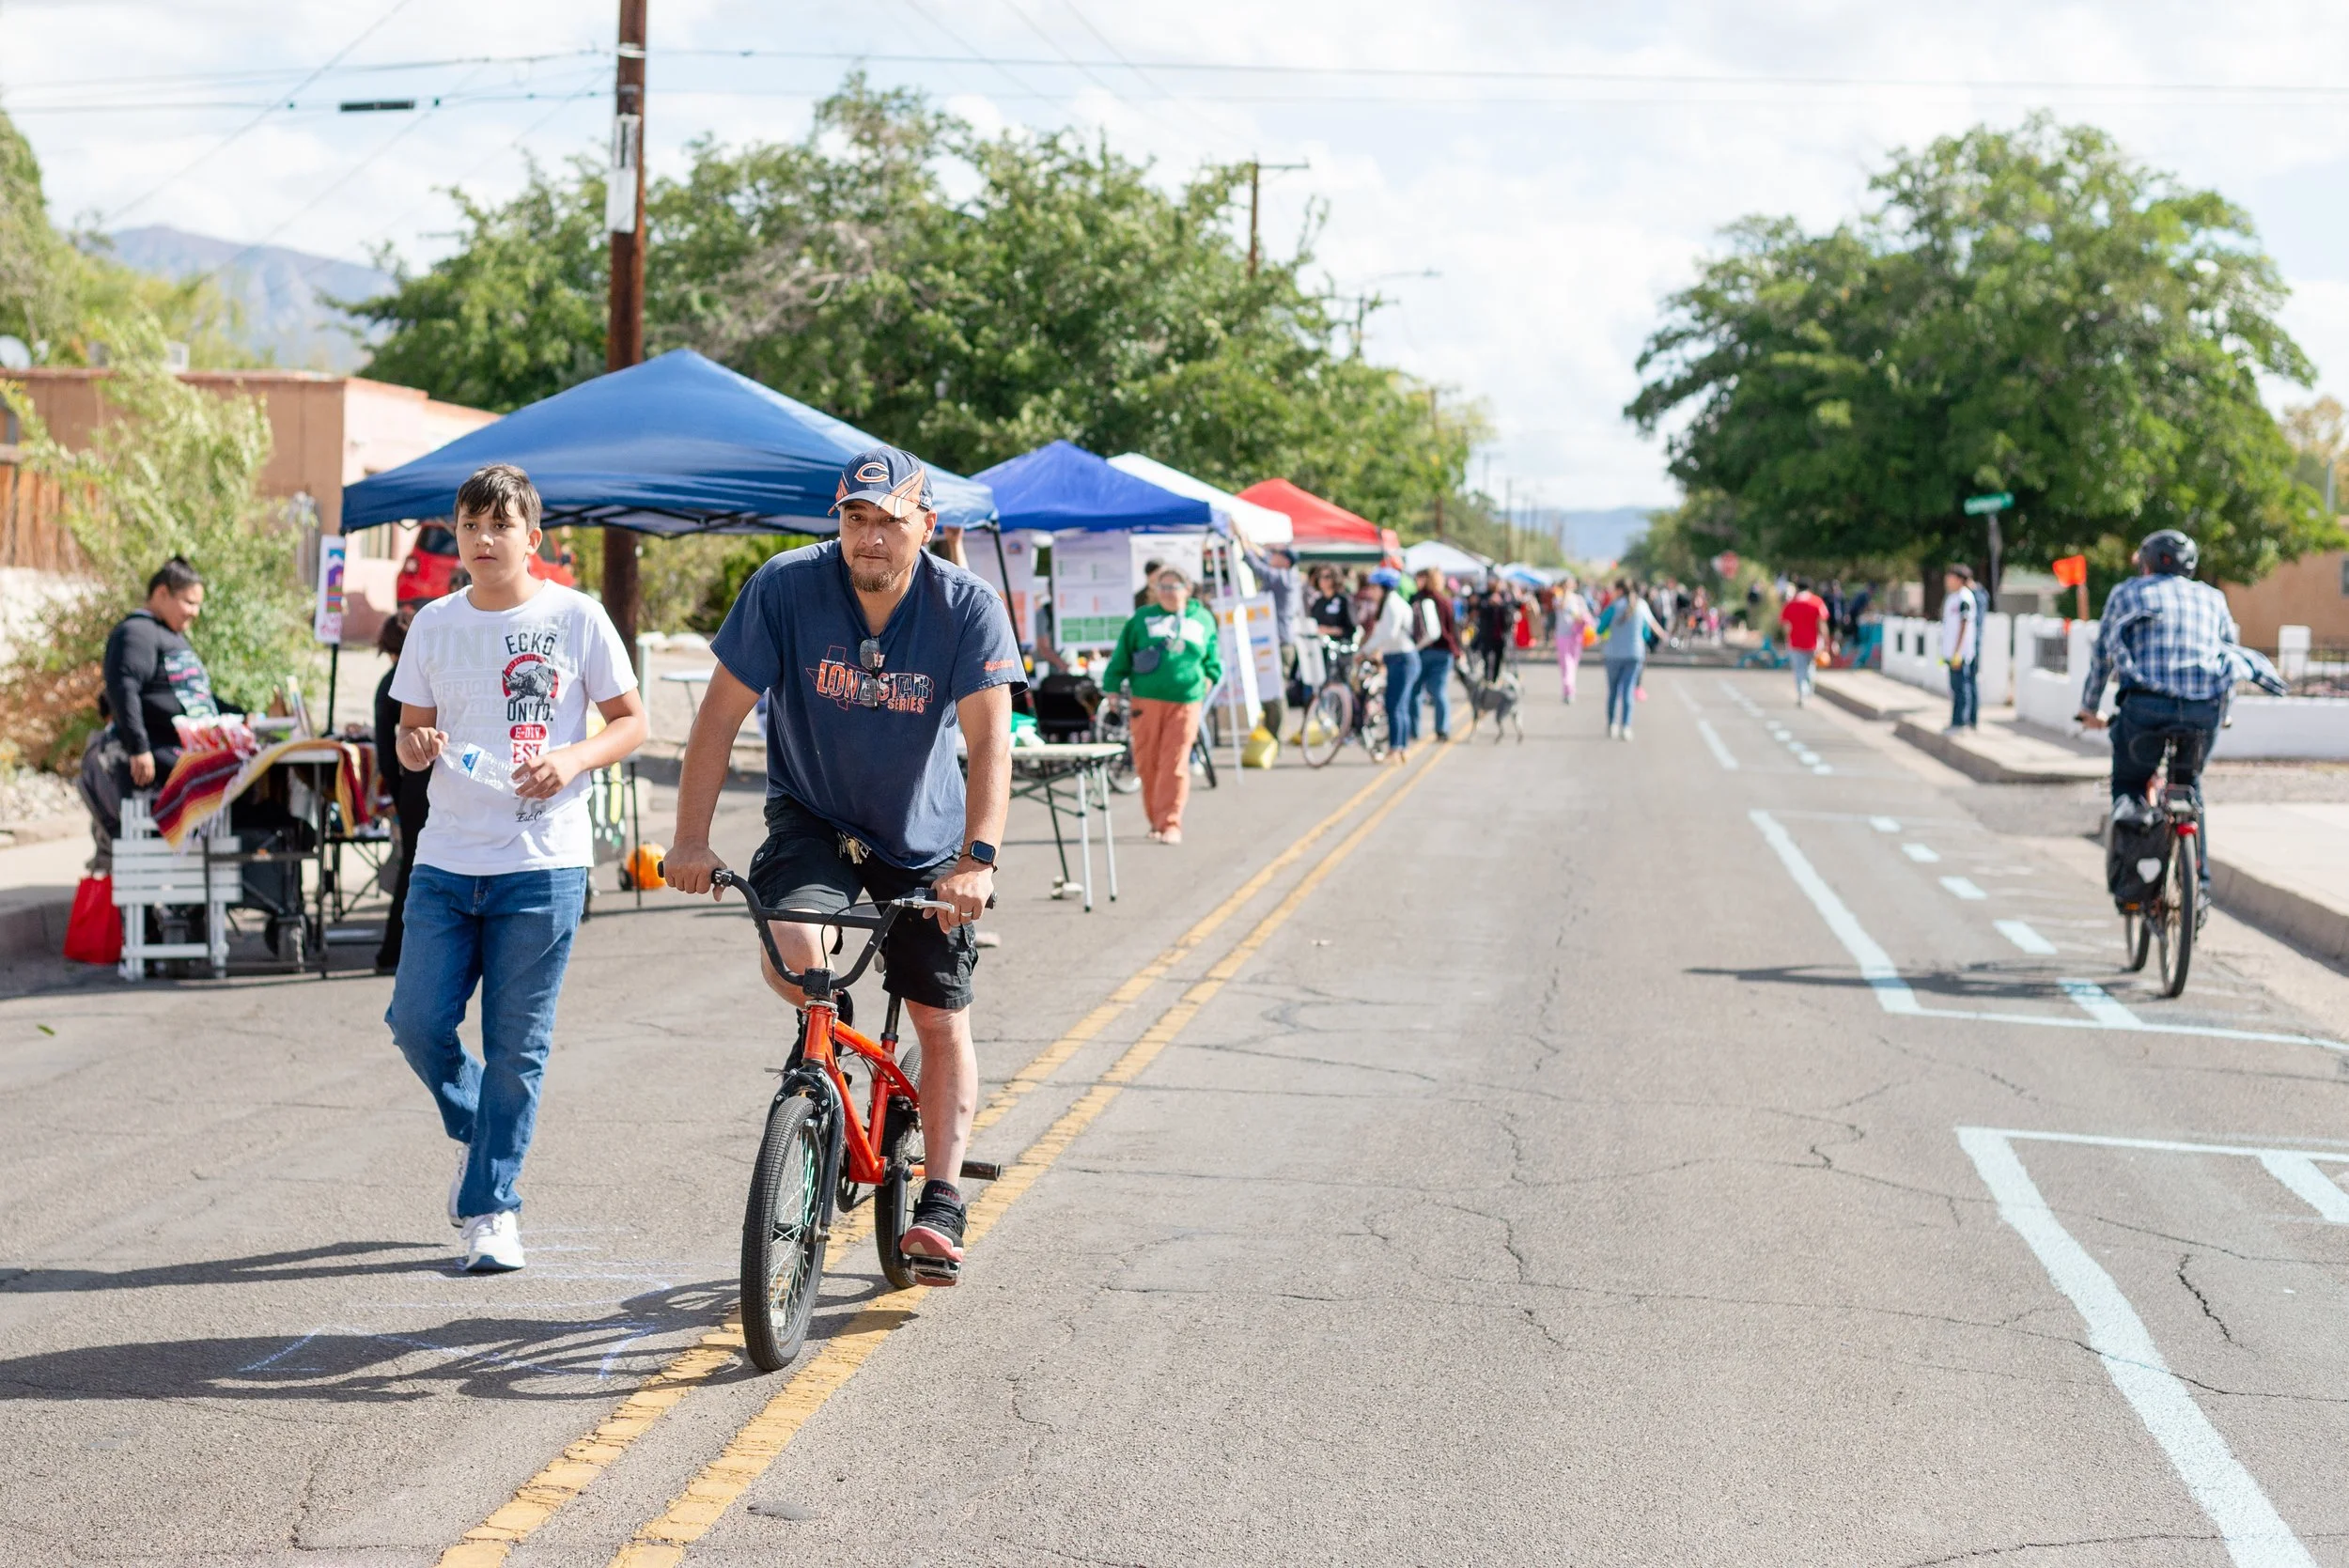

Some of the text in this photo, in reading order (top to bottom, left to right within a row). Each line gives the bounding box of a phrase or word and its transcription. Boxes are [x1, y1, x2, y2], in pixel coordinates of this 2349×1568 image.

[816, 661, 930, 701] LONE STAR
[887, 696, 926, 714] SERIES
